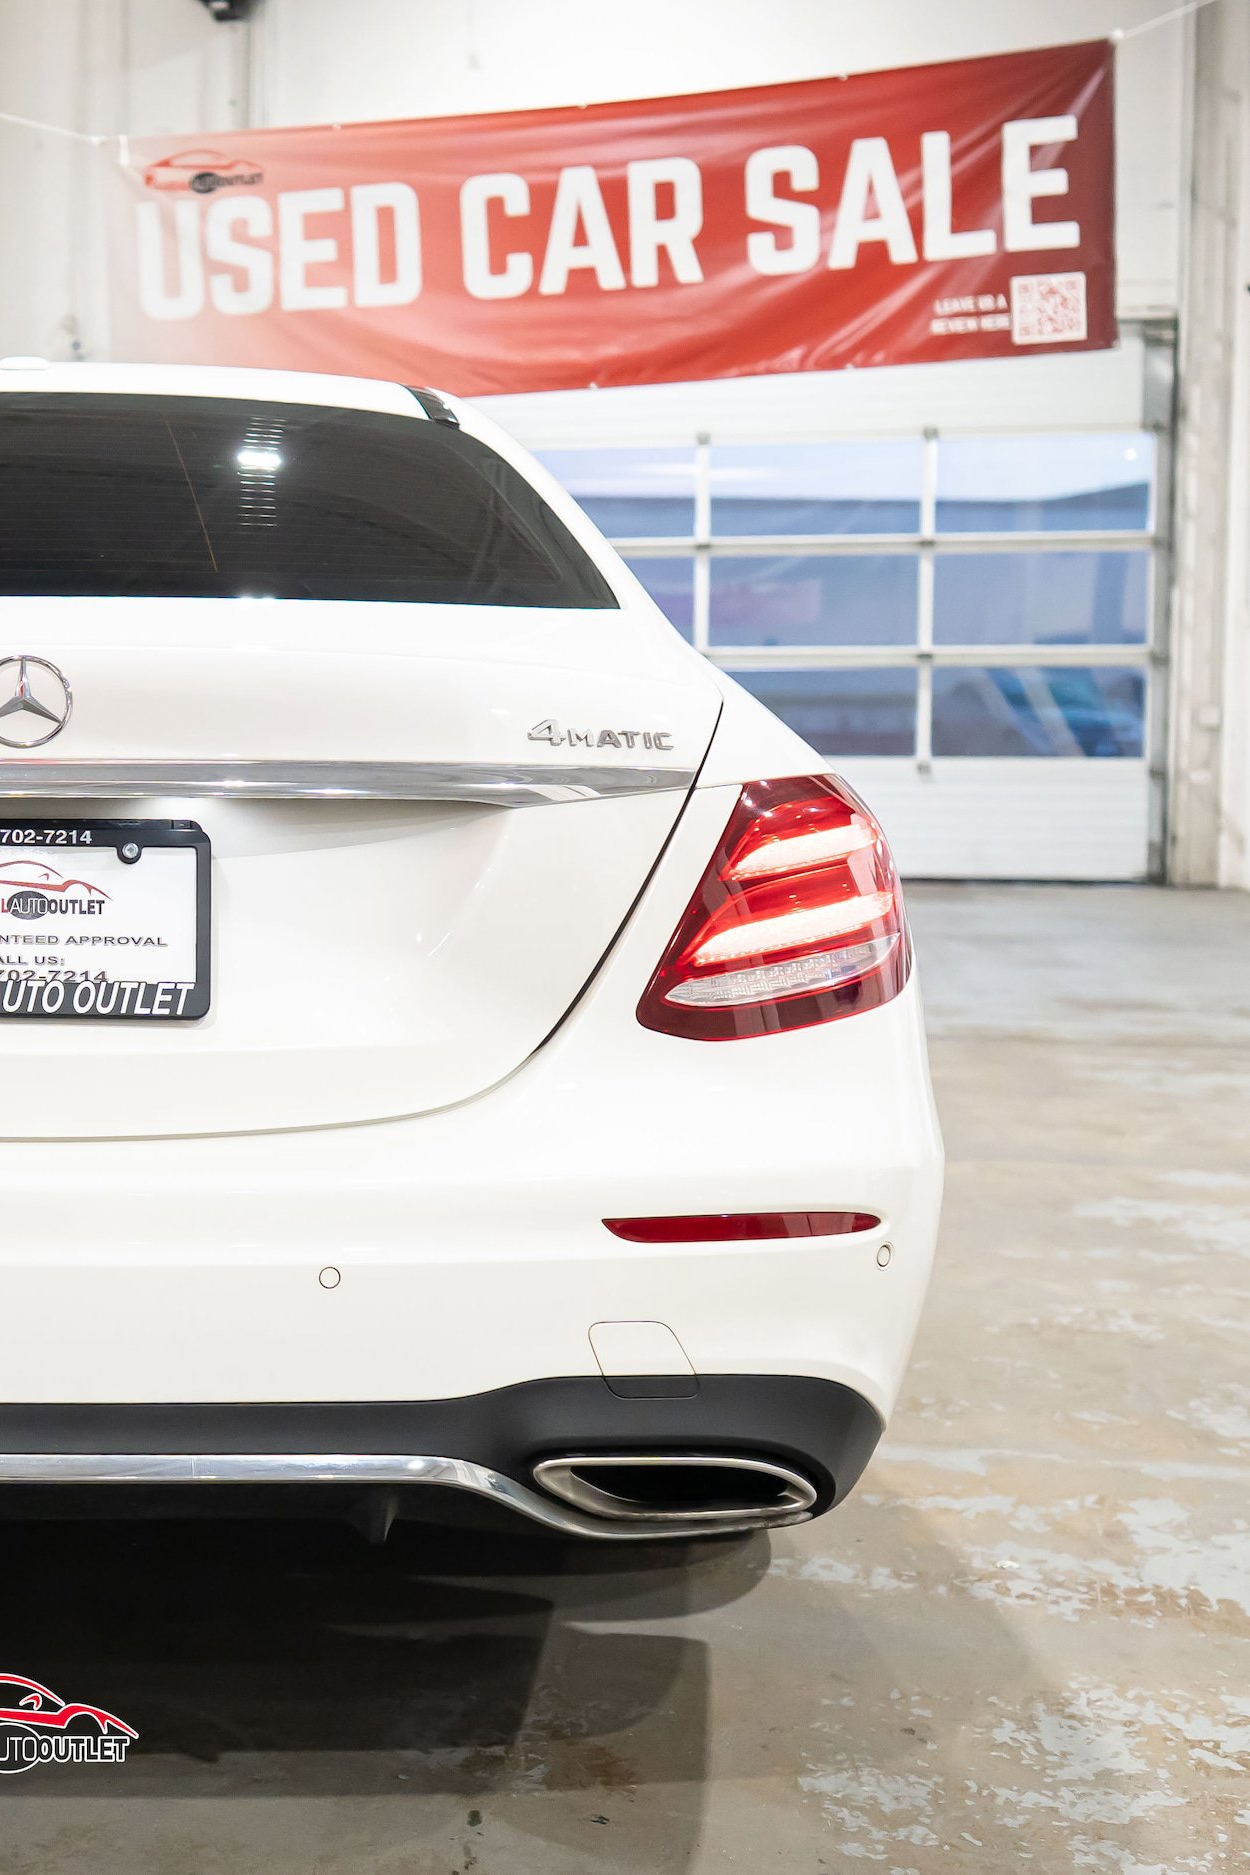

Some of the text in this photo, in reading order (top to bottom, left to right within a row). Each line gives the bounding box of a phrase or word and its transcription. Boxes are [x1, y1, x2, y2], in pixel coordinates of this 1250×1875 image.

[136, 114, 1081, 321] USED CAR SALE
[527, 719, 674, 750] 4MATIC
[65, 934, 168, 948] APPROVAL
[34, 956, 66, 966] US:
[72, 980, 195, 1016] OUTLET
